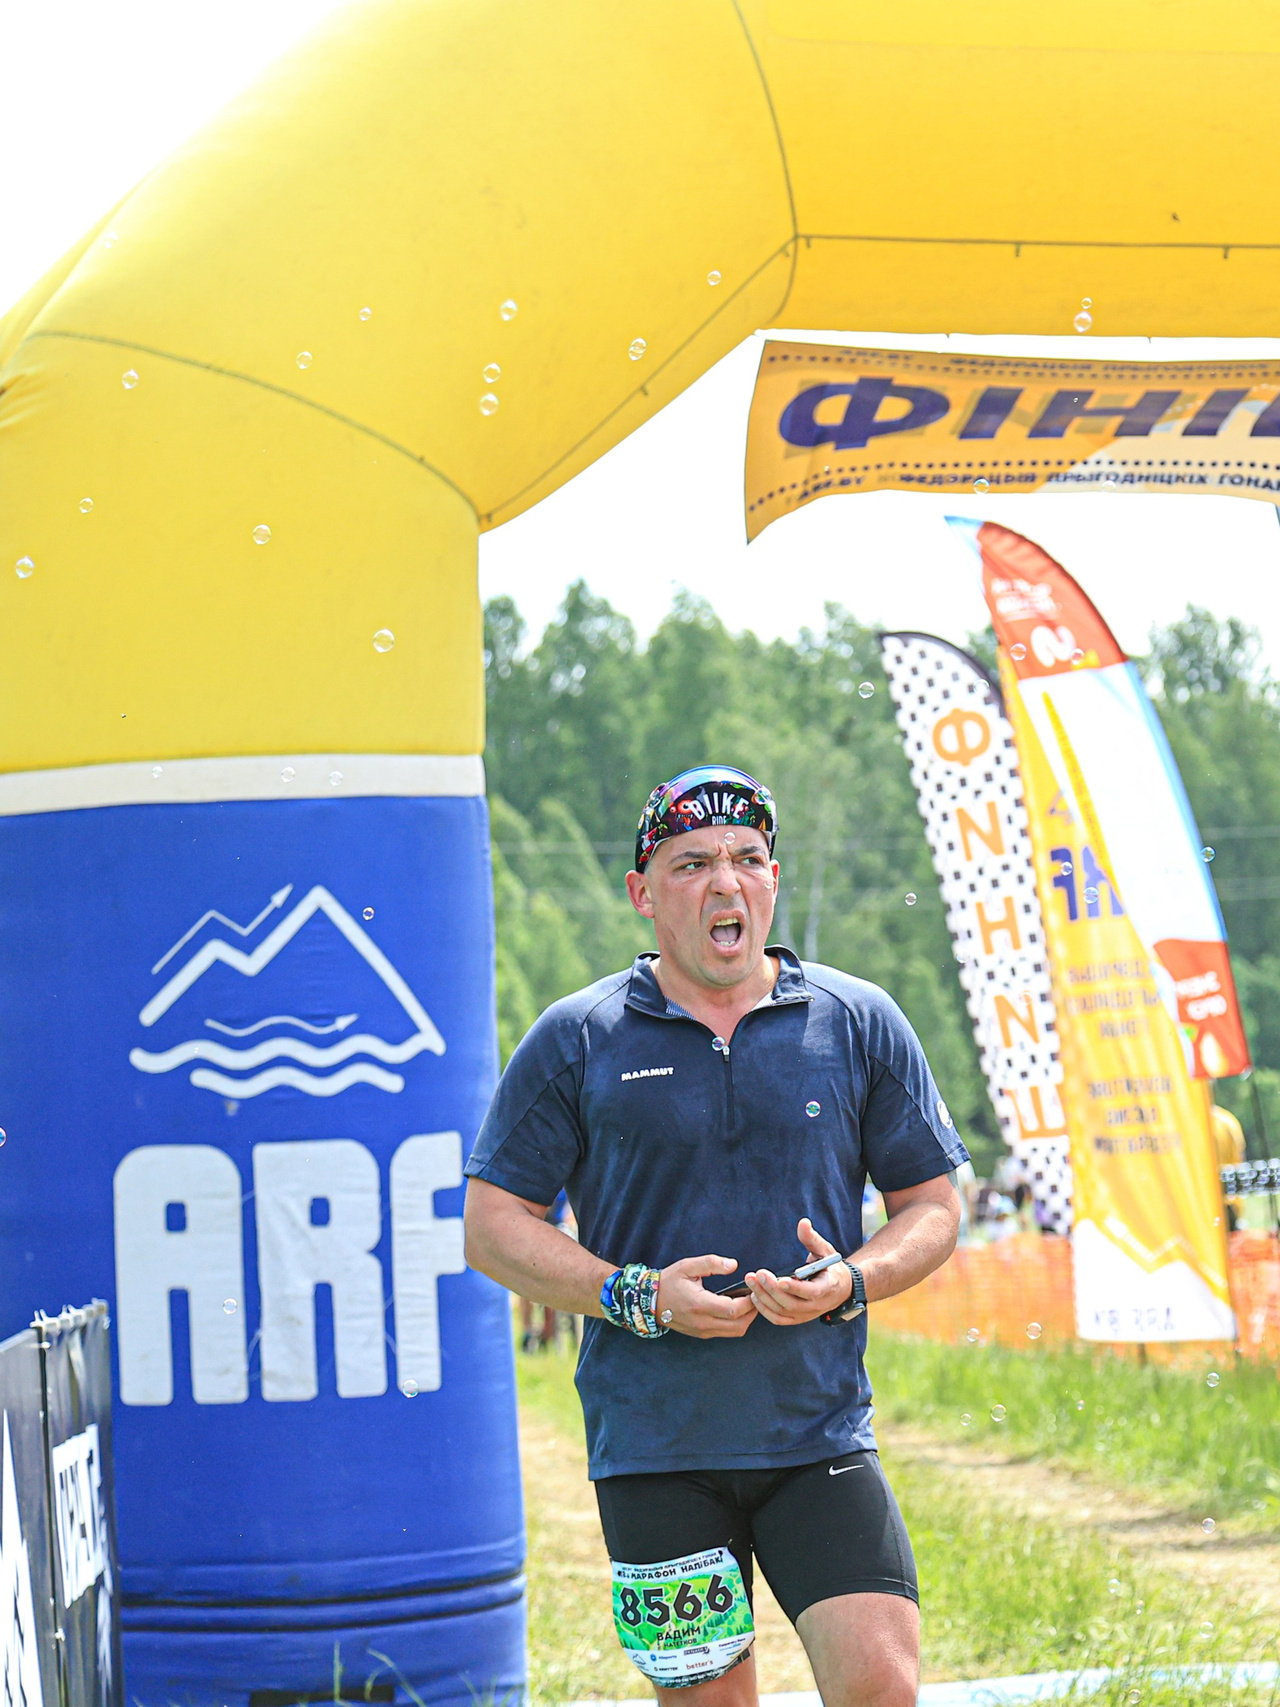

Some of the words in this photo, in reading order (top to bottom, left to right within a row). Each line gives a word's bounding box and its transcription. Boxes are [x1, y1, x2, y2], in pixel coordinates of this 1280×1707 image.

[621, 1066, 674, 1081] MAMMUT
[112, 1131, 467, 1406] ARF
[619, 1573, 734, 1628] 8566
[656, 1626, 702, 1642] ВАДИМ
[686, 1659, 714, 1670] better's
